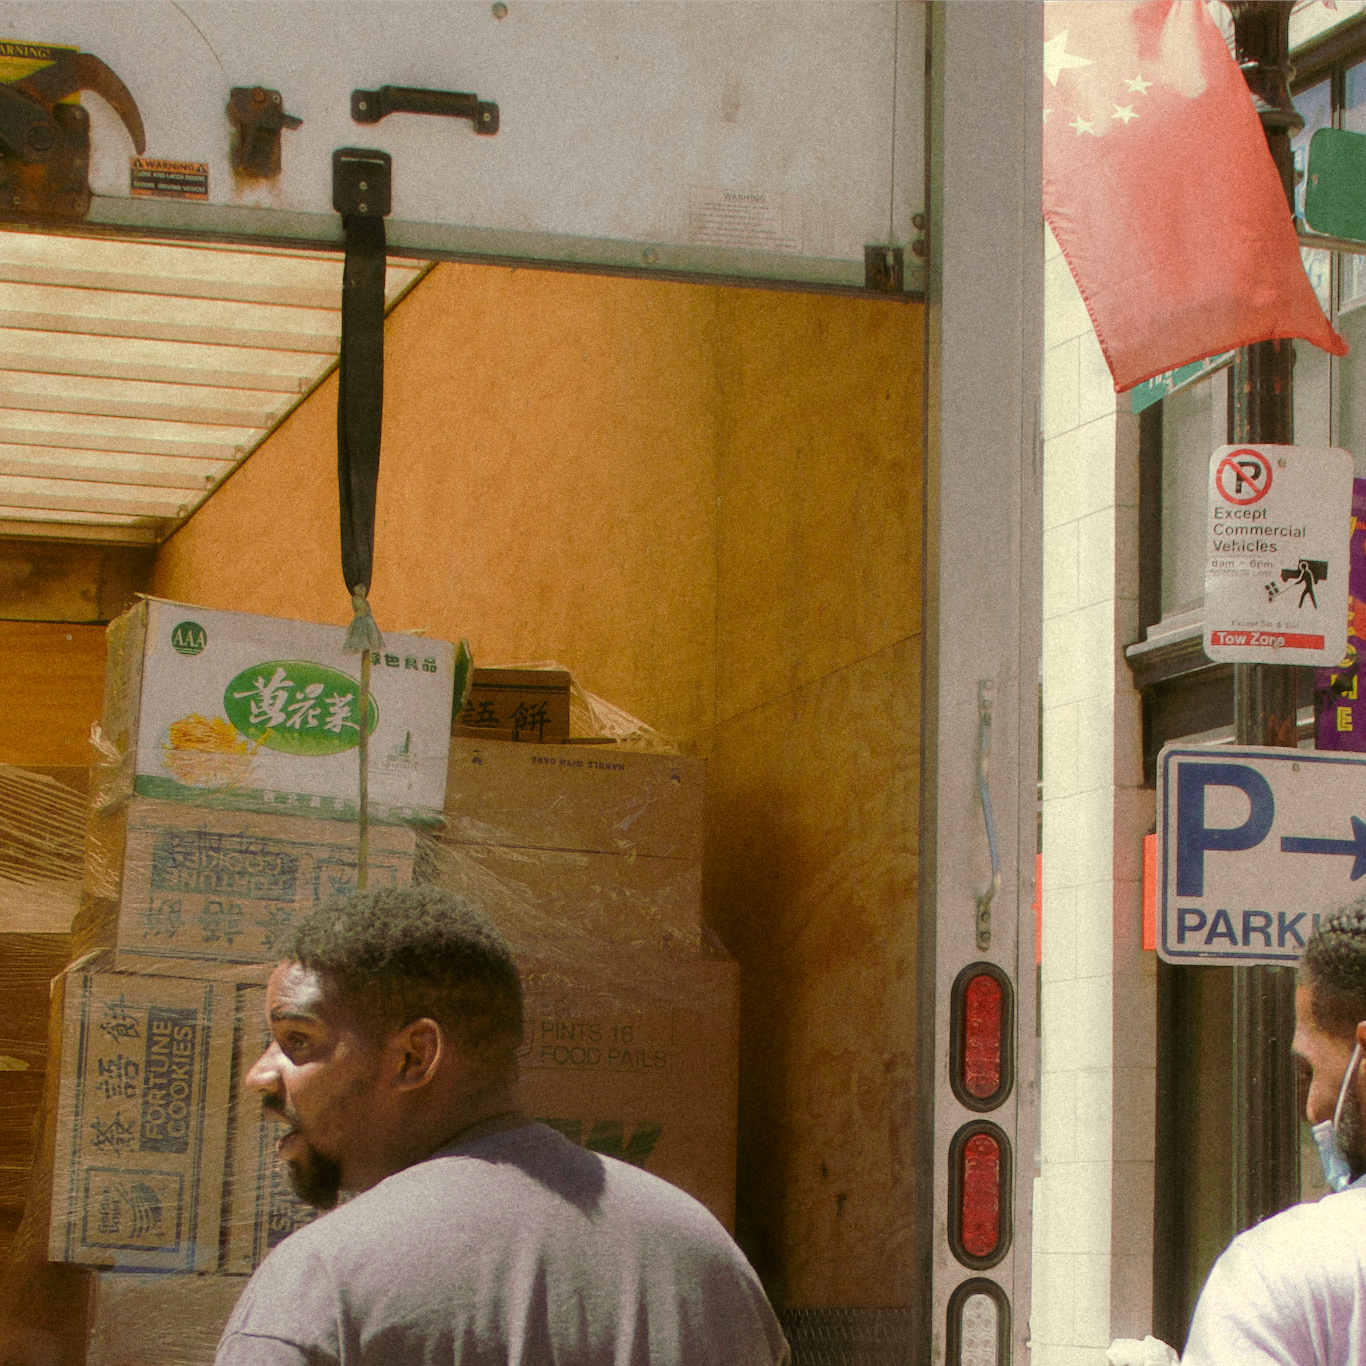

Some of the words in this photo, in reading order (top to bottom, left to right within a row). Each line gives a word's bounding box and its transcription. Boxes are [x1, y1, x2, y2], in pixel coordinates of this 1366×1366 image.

[1214, 507, 1267, 522] Except
[1213, 523, 1306, 538] Commercial
[1212, 540, 1278, 553] Vehicles
[175, 629, 207, 647] AAA
[1216, 631, 1247, 645] Tow
[1249, 633, 1286, 647] Zone
[531, 756, 556, 766] CARE
[560, 759, 585, 769] WITH
[587, 761, 625, 772] HANDLE
[1176, 762, 1276, 898] P
[162, 867, 286, 893] FORTUNE
[541, 1021, 603, 1042] PINTS
[610, 1024, 634, 1044] 16
[540, 1045, 602, 1067] FOOD
[608, 1046, 668, 1069] PAILS
[145, 1020, 173, 1140] FORTUNE
[167, 1025, 193, 1139] COOKIES
